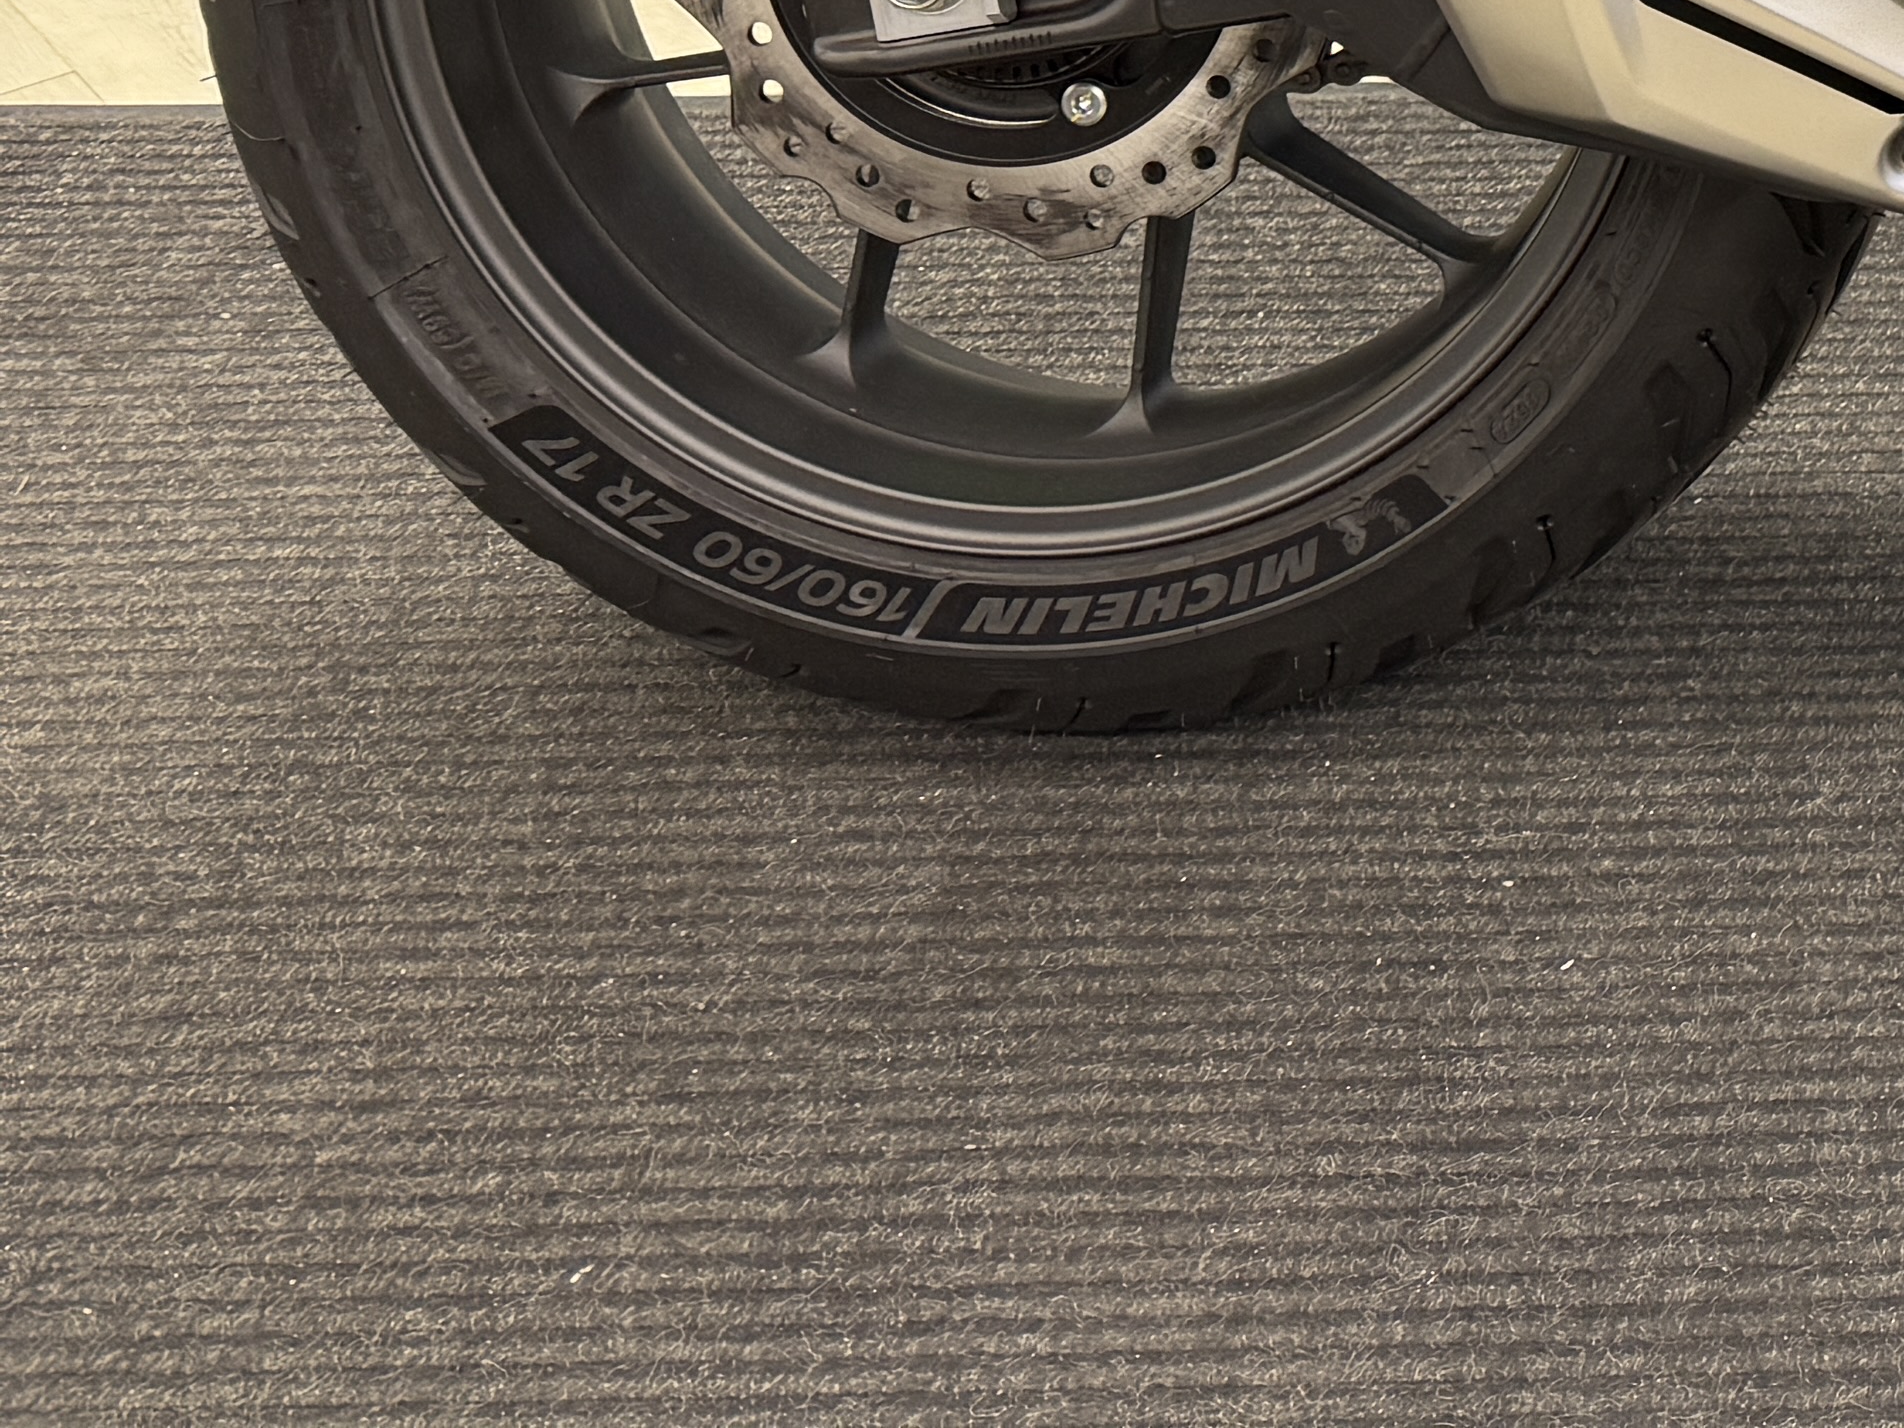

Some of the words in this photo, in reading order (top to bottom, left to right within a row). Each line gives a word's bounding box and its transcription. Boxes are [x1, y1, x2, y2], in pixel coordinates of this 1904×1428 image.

[521, 436, 599, 482] 17
[596, 476, 692, 540] ZR
[693, 530, 912, 623] 160/60
[961, 537, 1320, 635] MICHELIN
